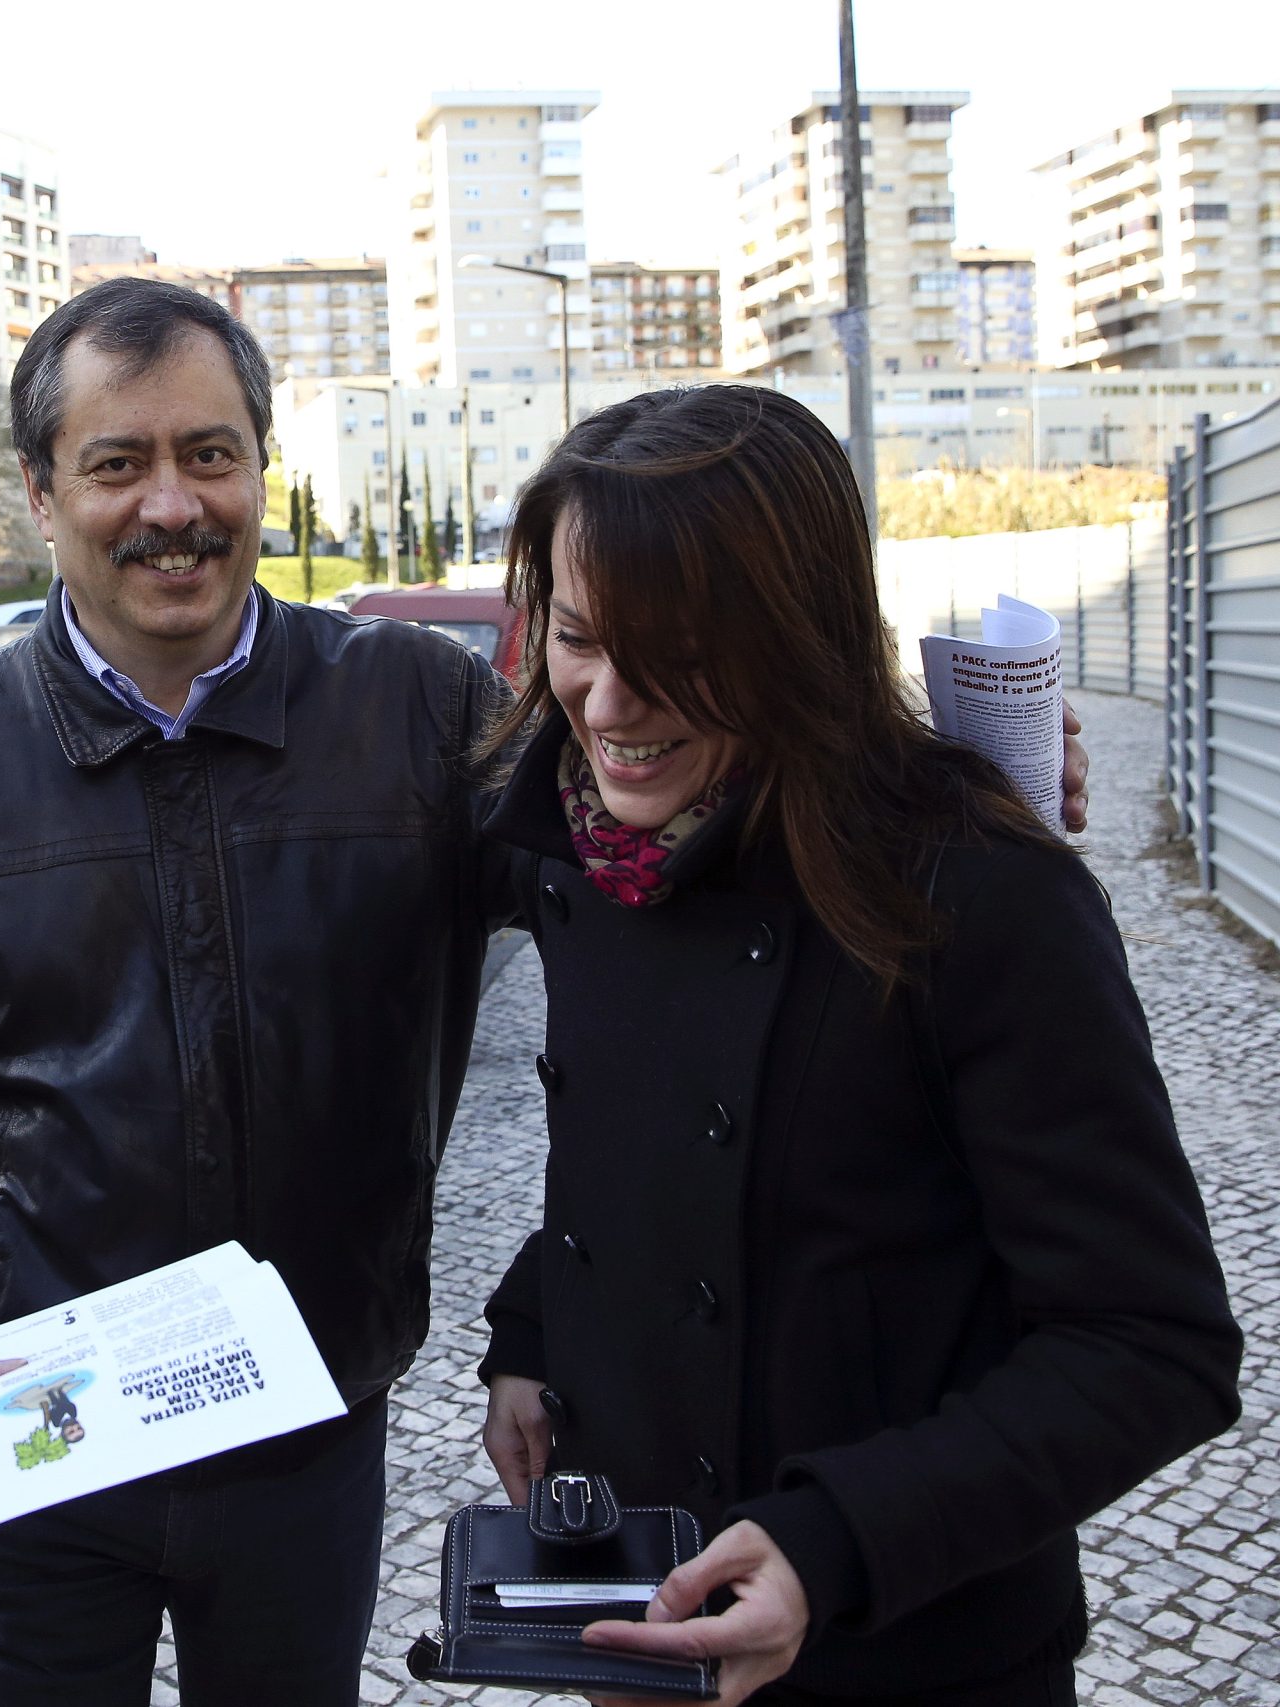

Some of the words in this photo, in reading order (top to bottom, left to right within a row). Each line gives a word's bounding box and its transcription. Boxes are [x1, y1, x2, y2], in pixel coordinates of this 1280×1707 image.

[952, 653, 959, 662] A
[961, 654, 987, 667] PACC
[989, 657, 1048, 669] confirmaria
[1049, 653, 1055, 661] a
[952, 667, 999, 681] enquanto
[1002, 672, 1042, 682] docente
[1051, 665, 1056, 673] a
[953, 678, 999, 693] trabalho?
[1002, 685, 1009, 694] E
[1011, 687, 1023, 695] se
[1026, 684, 1042, 694] um
[1045, 677, 1057, 689] dia
[211, 1344, 224, 1354] 26
[228, 1337, 245, 1347] 25,
[186, 1352, 197, 1363] 27
[203, 1349, 209, 1357] E
[214, 1349, 252, 1367] UMA
[168, 1359, 181, 1369] DE
[245, 1359, 256, 1369] O
[119, 1364, 163, 1384] MARÇO
[122, 1361, 211, 1396] PROFISSÃO
[172, 1363, 240, 1392] SENTIDO
[249, 1369, 260, 1380] A
[205, 1374, 246, 1394] PACC
[254, 1379, 264, 1390] A
[147, 1387, 167, 1400] DE
[167, 1389, 200, 1405] TEM
[211, 1384, 250, 1403] LUTA
[141, 1398, 206, 1425] CONTRA
